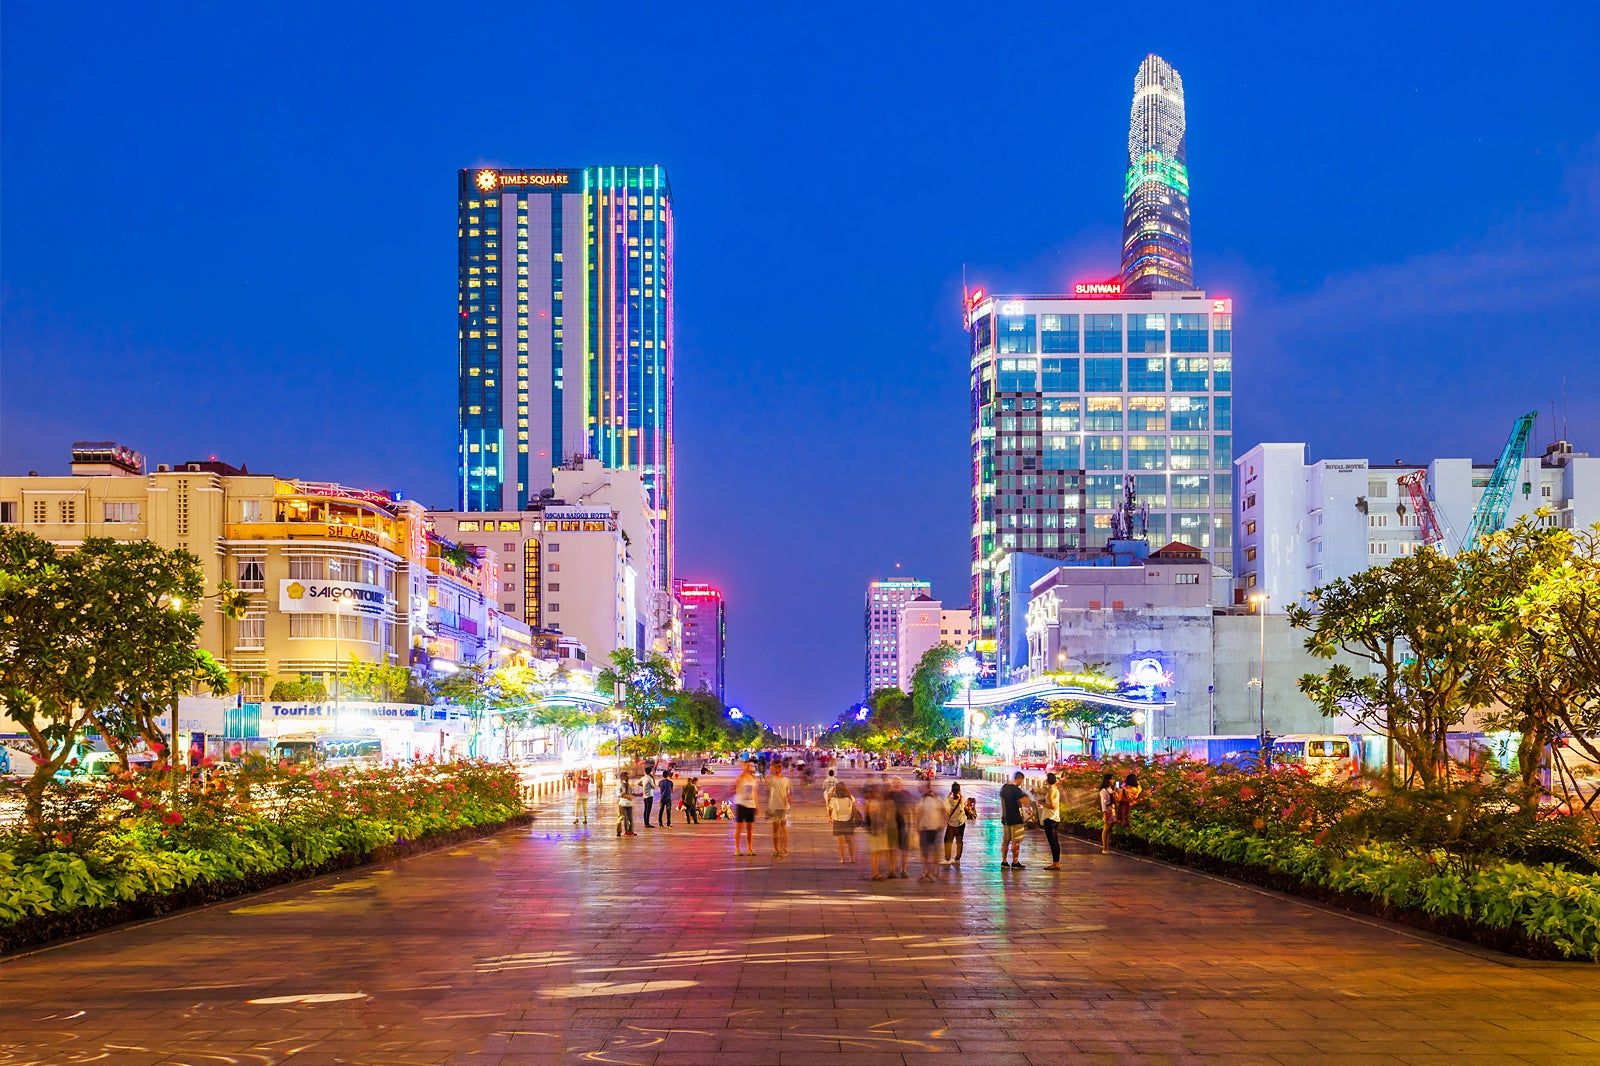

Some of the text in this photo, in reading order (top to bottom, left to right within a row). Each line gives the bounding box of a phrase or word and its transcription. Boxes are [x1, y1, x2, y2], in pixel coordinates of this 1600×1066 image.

[499, 175, 569, 186] TIMES SQUARE
[1075, 284, 1121, 294] SUNWAH
[272, 704, 322, 716] Tourist
